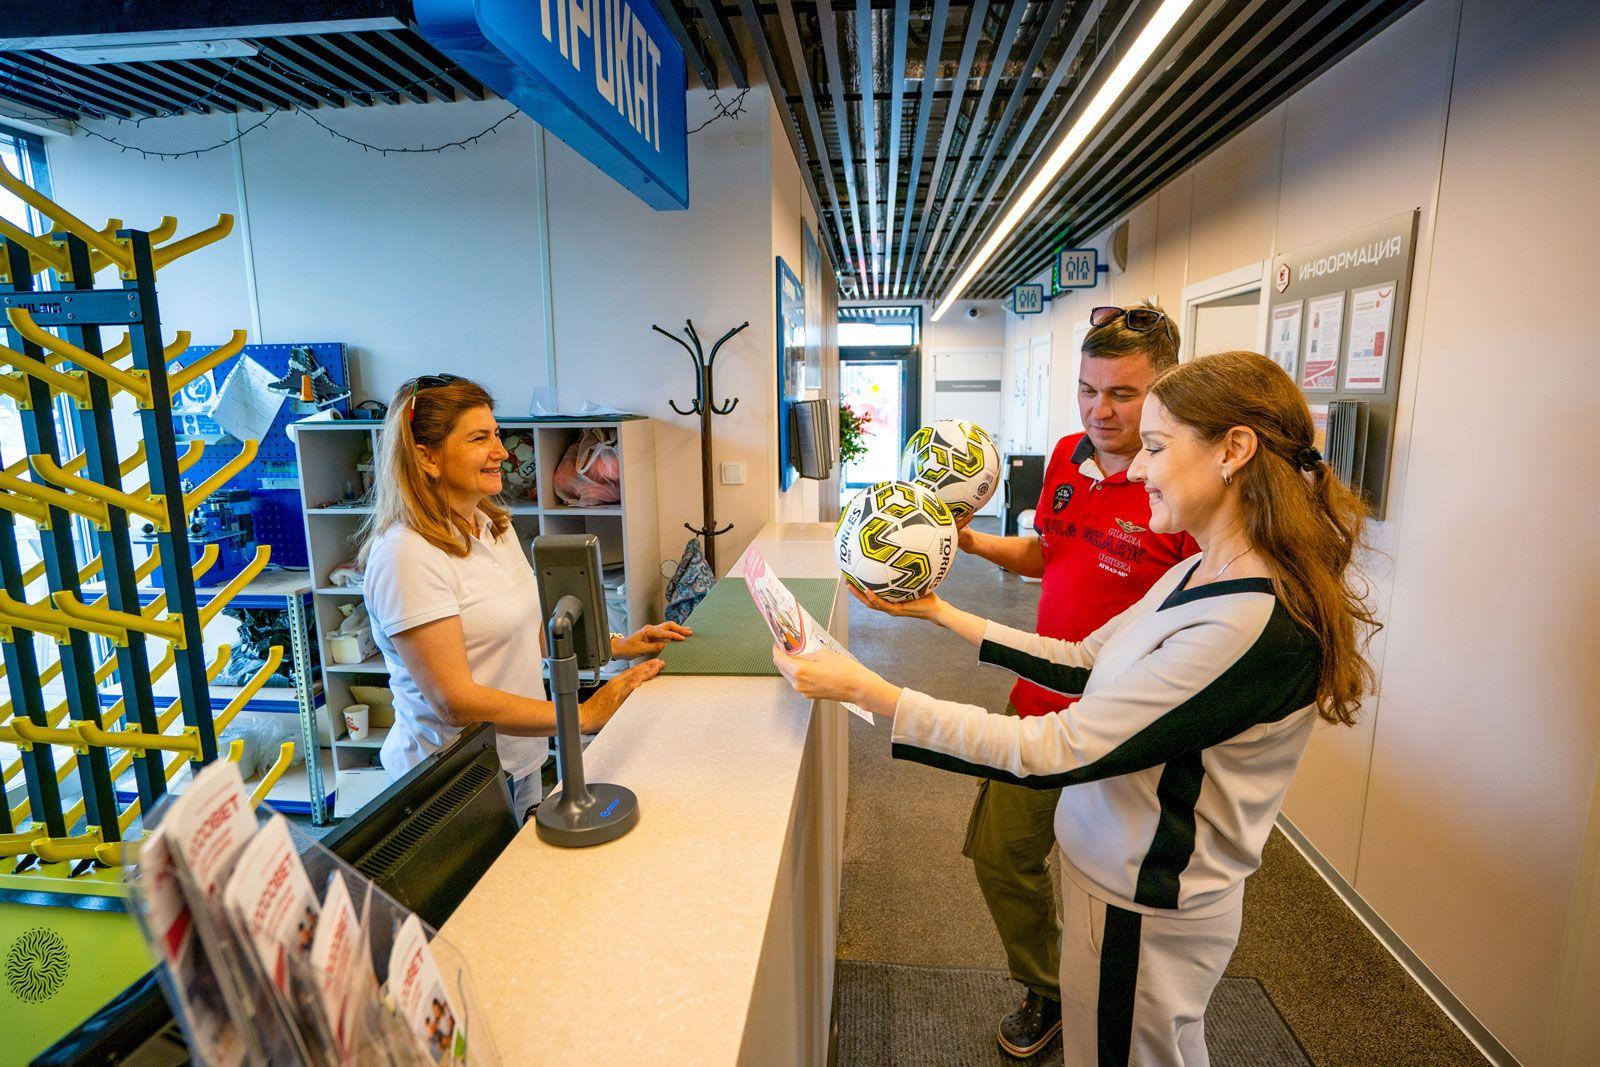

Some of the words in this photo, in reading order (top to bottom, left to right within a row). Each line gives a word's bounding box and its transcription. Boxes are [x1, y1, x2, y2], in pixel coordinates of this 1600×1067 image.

[1299, 235, 1402, 281] ИНФОРМАЦИЯ
[928, 535, 952, 590] TORRES
[1082, 526, 1147, 565] SHARK
